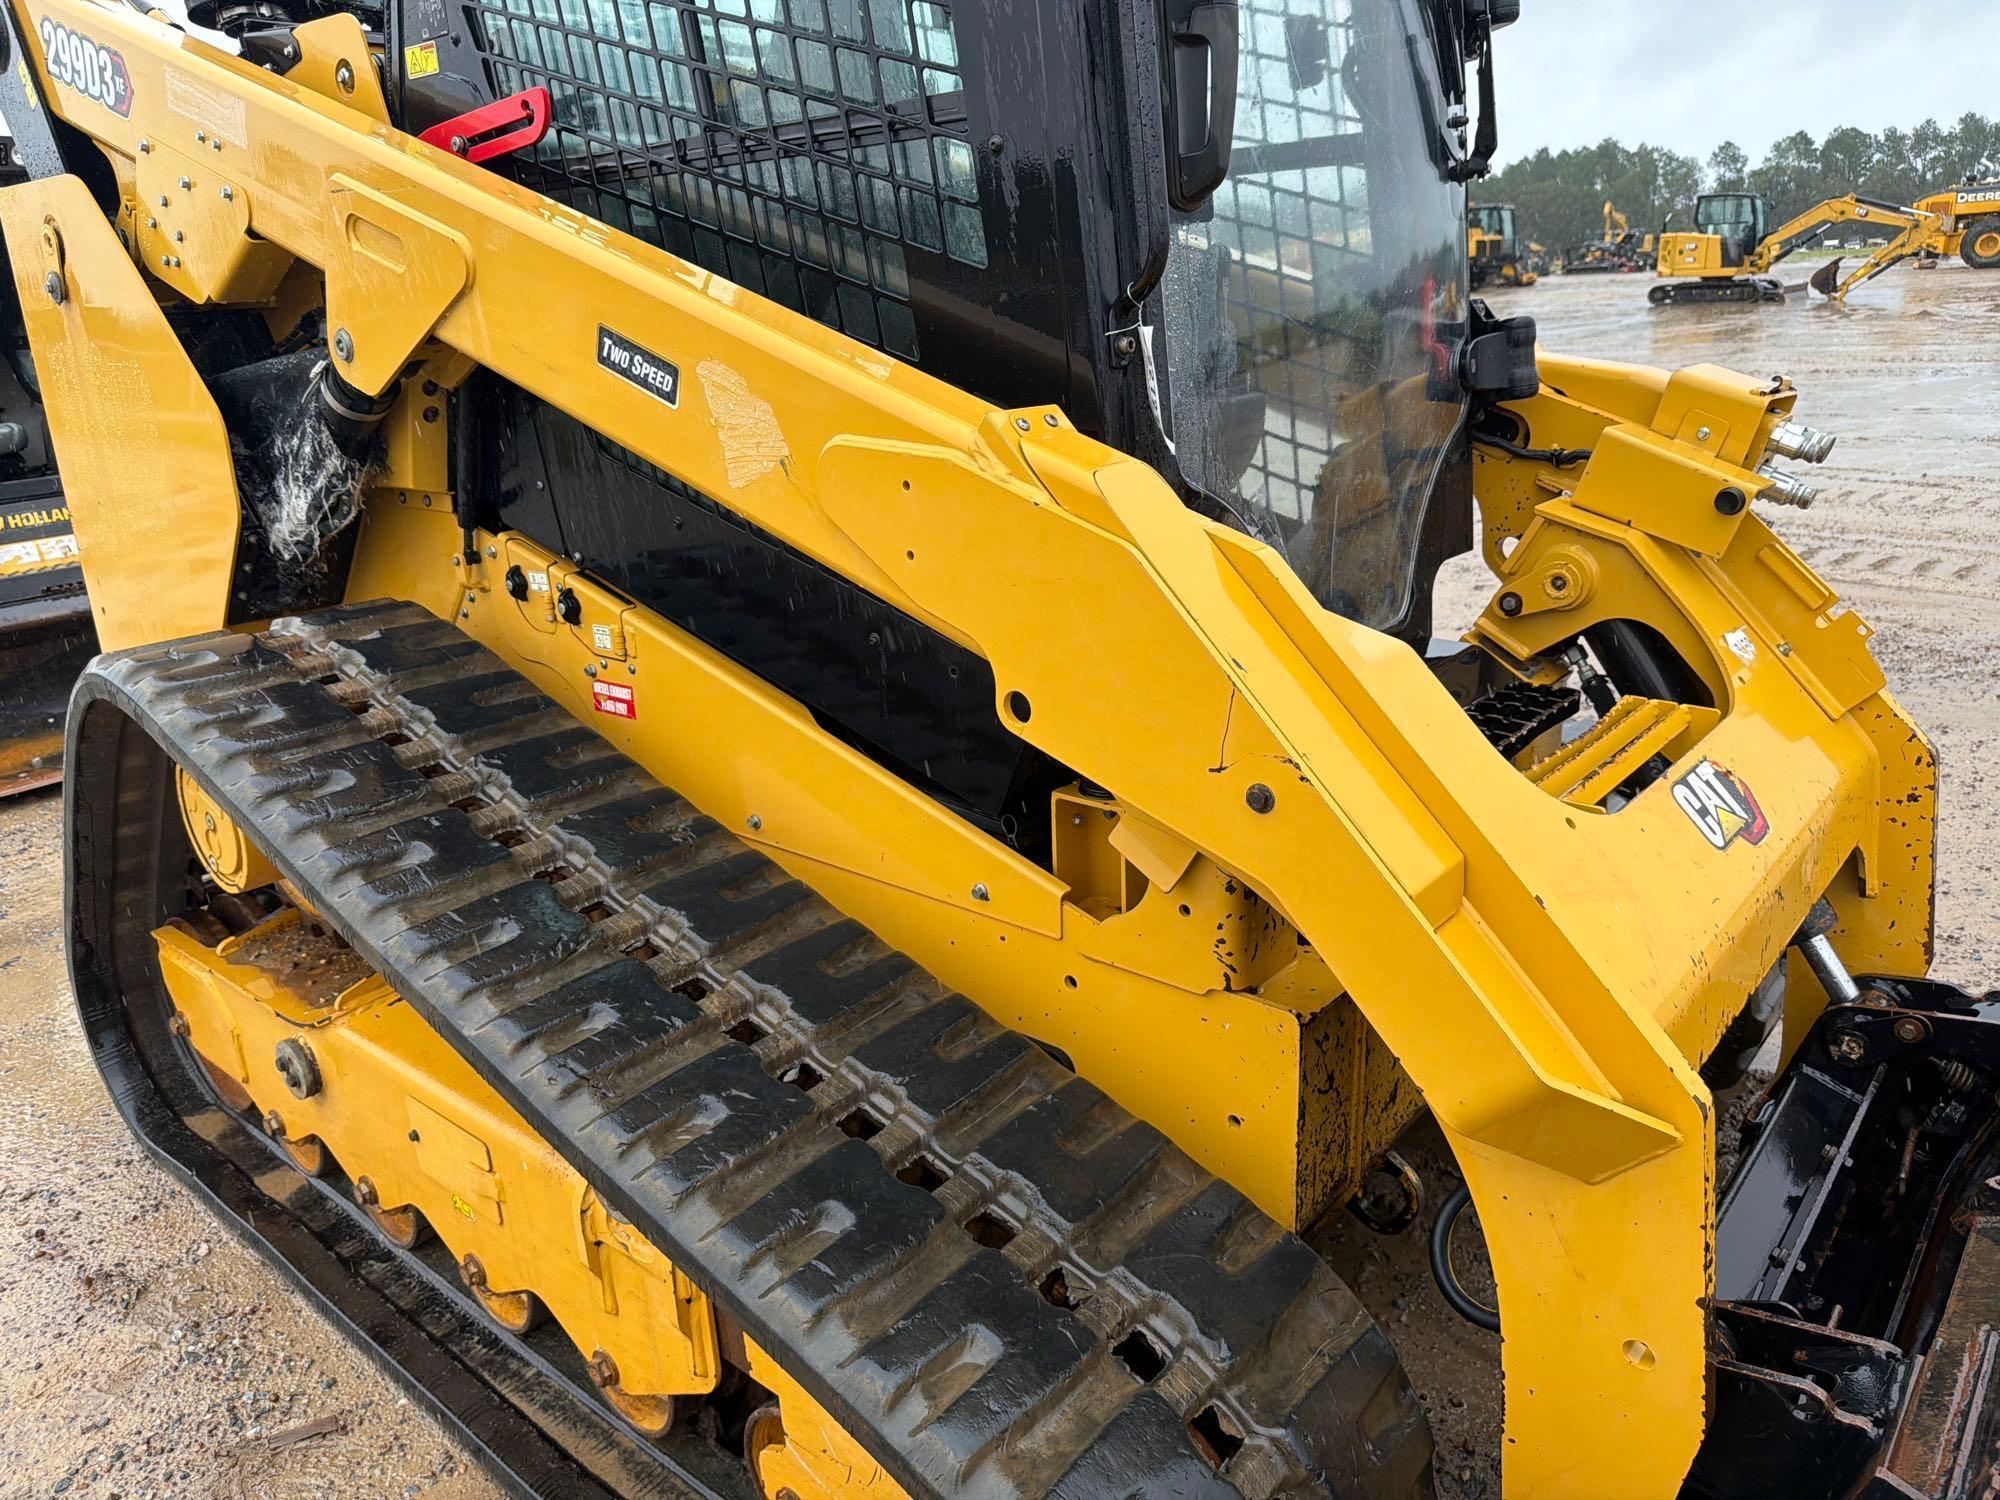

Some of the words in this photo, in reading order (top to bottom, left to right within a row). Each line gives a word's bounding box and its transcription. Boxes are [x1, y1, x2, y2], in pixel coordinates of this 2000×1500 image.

[42, 19, 115, 107] 299D3
[1957, 191, 2000, 203] DEERE
[1672, 760, 1749, 848] CAT
